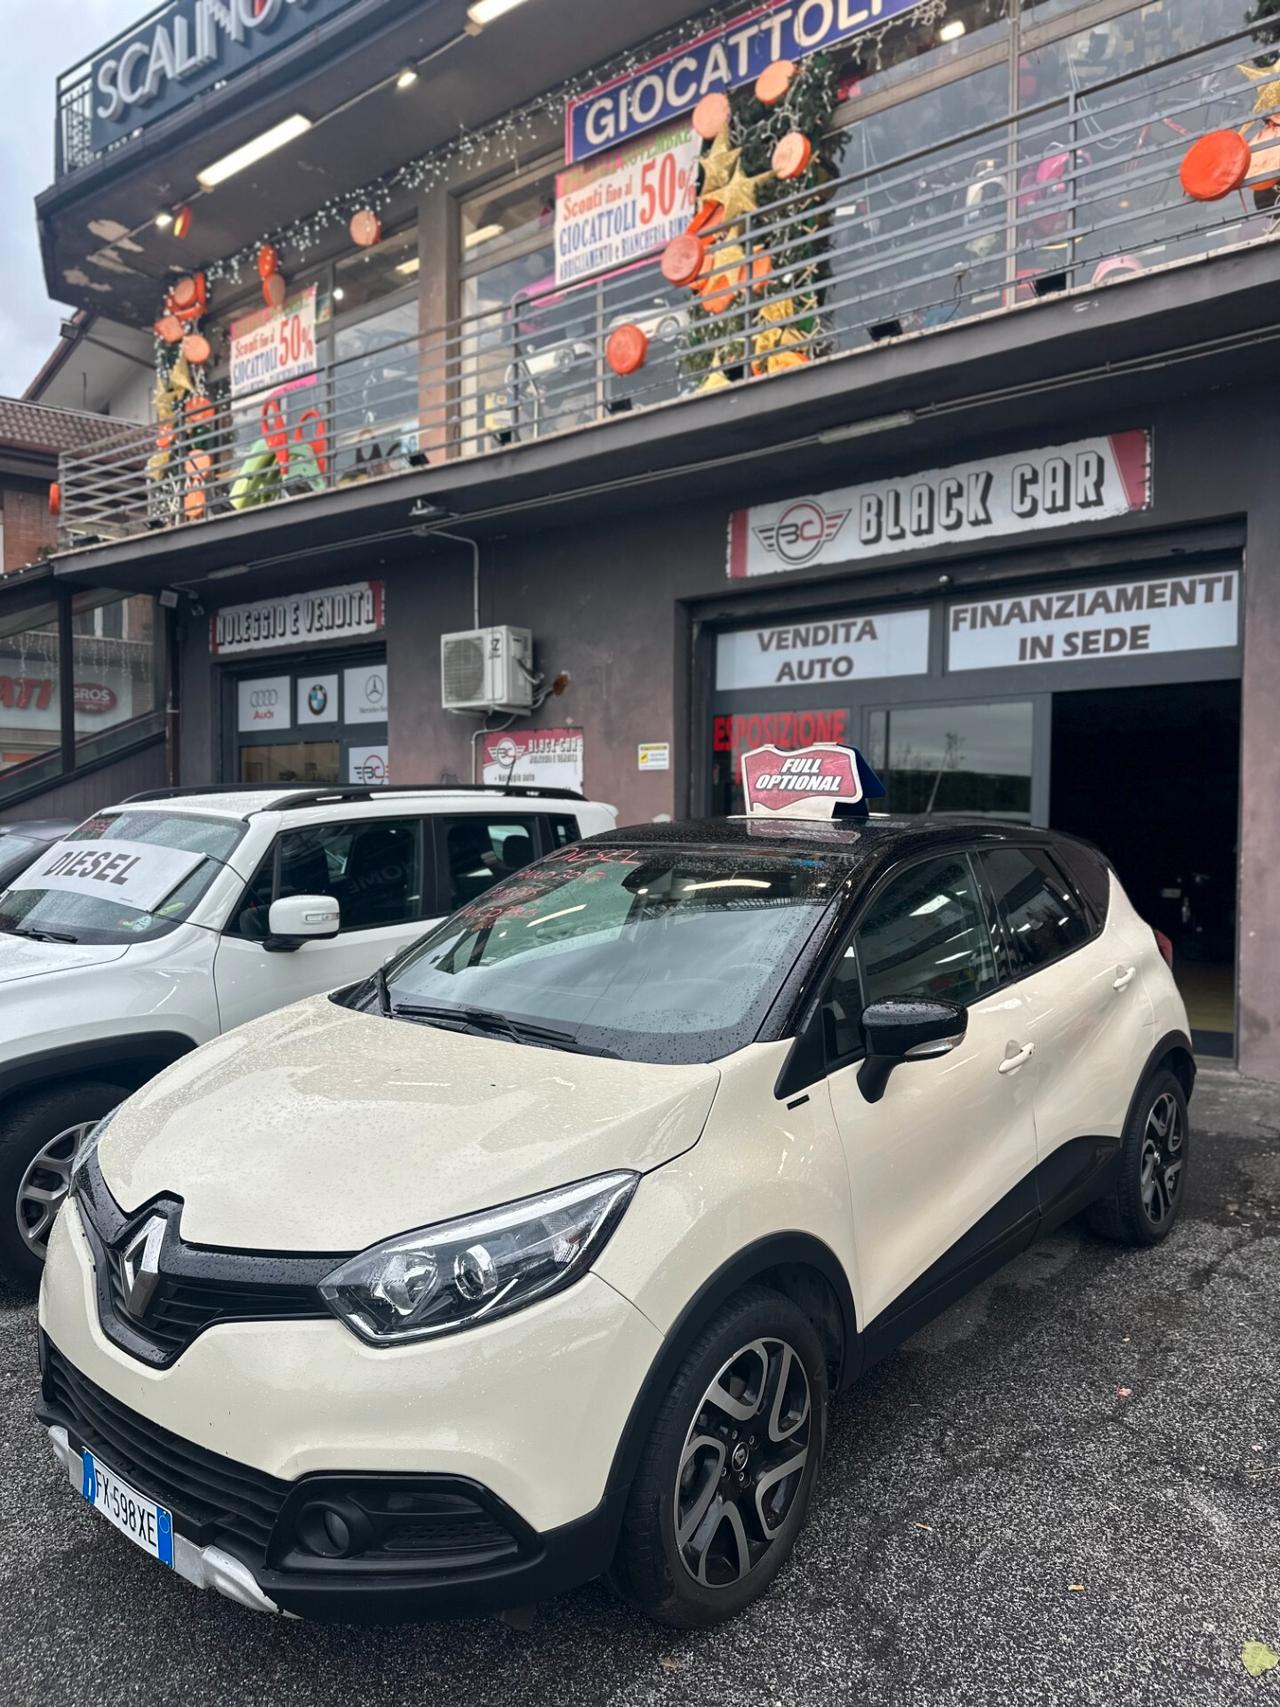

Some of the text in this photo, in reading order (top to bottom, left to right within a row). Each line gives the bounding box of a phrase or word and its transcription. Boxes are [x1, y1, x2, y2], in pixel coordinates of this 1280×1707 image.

[639, 152, 697, 225] 50%
[559, 200, 637, 257] GIOCATTOLI
[279, 314, 313, 366] 50%
[858, 470, 994, 546] BLACK
[1011, 450, 1104, 518] CAR
[216, 589, 375, 647] NOLEGGIO E VENDITA
[952, 575, 1234, 632] FINANZIAMENTI
[757, 619, 878, 653] VENDITA
[1018, 624, 1151, 662] IN SEDE
[776, 656, 854, 684] AUTO
[713, 708, 849, 752] ESPOSIZIONE
[755, 775, 842, 791] OPTIONAL
[781, 758, 822, 774] FULL
[42, 851, 141, 886] DIESEL
